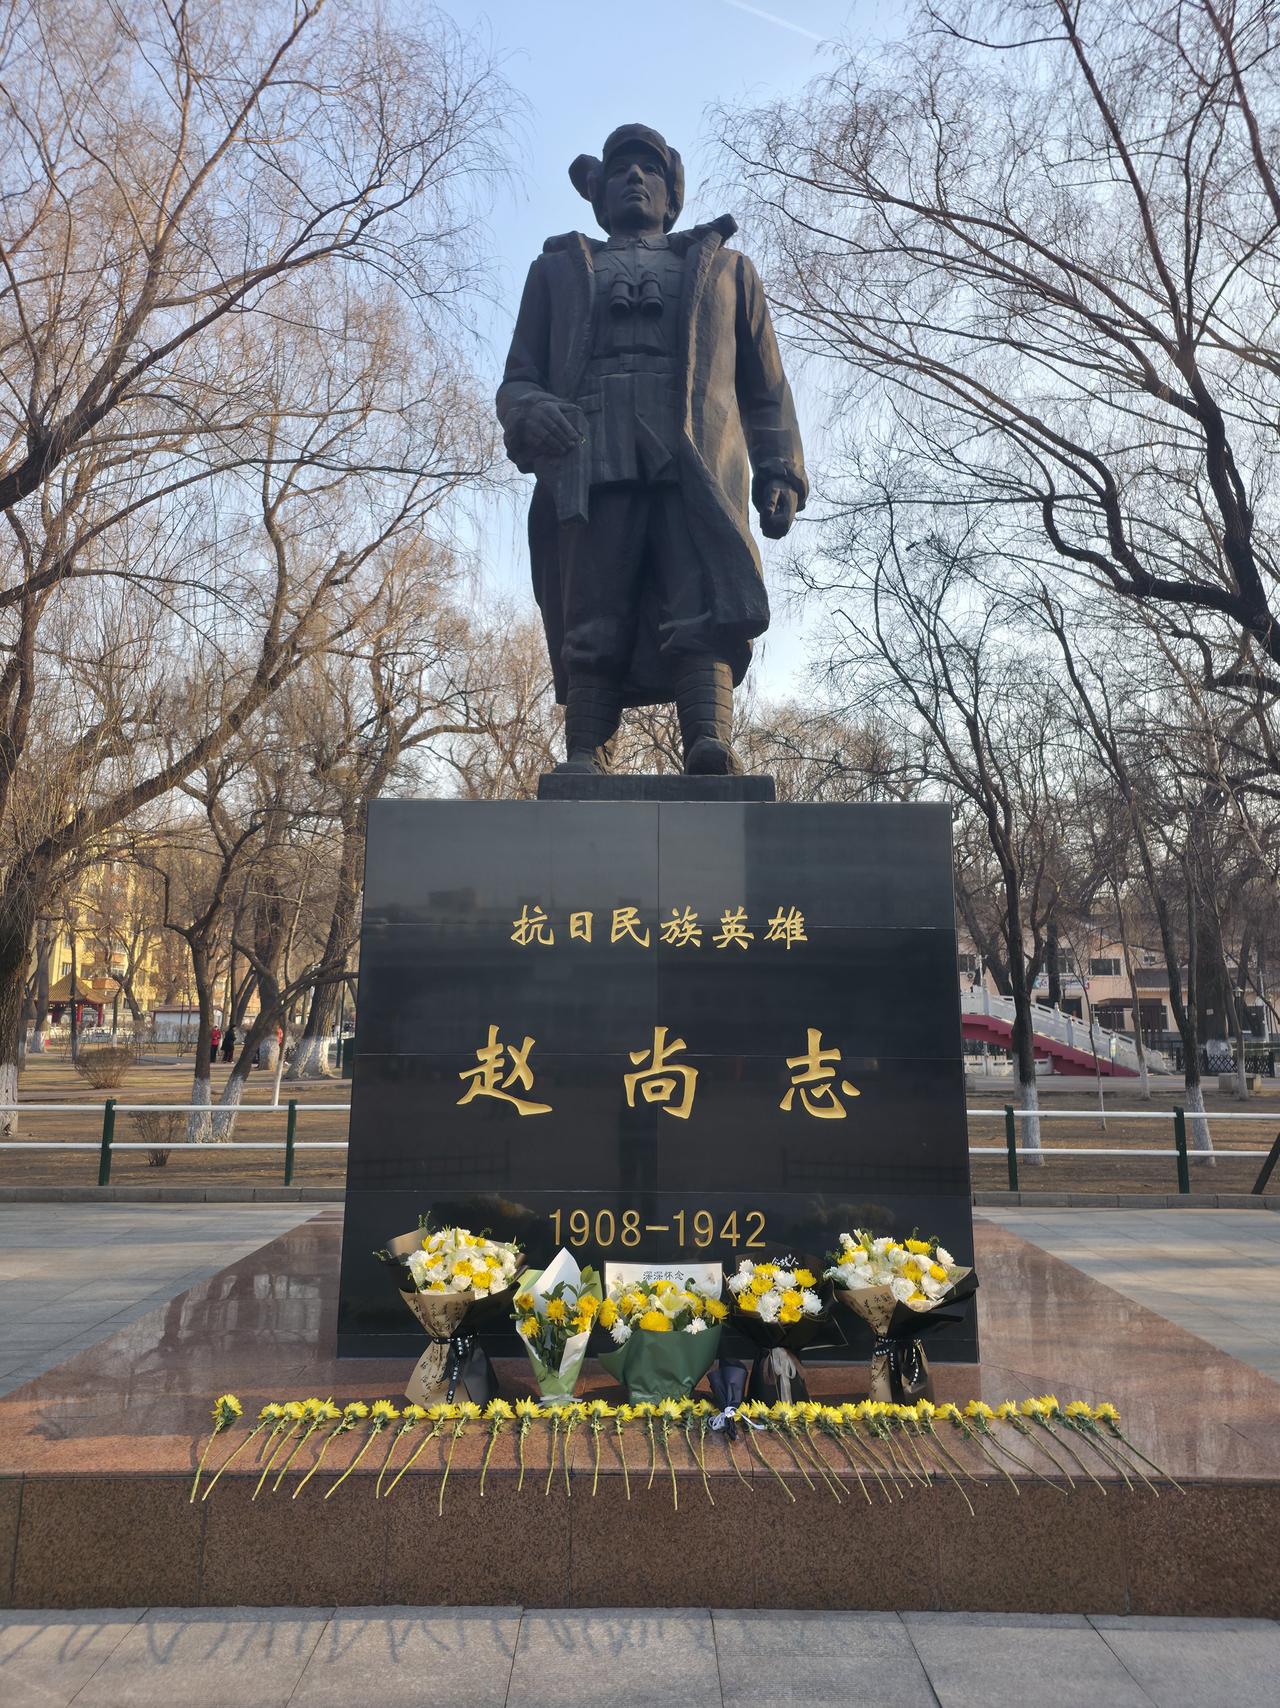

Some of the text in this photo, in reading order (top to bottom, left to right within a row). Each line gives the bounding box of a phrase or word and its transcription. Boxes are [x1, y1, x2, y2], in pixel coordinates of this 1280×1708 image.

[510, 904, 809, 950] 抗日民族英雄
[455, 1024, 862, 1120] 赵尚志
[548, 1208, 767, 1248] 1908-1942
